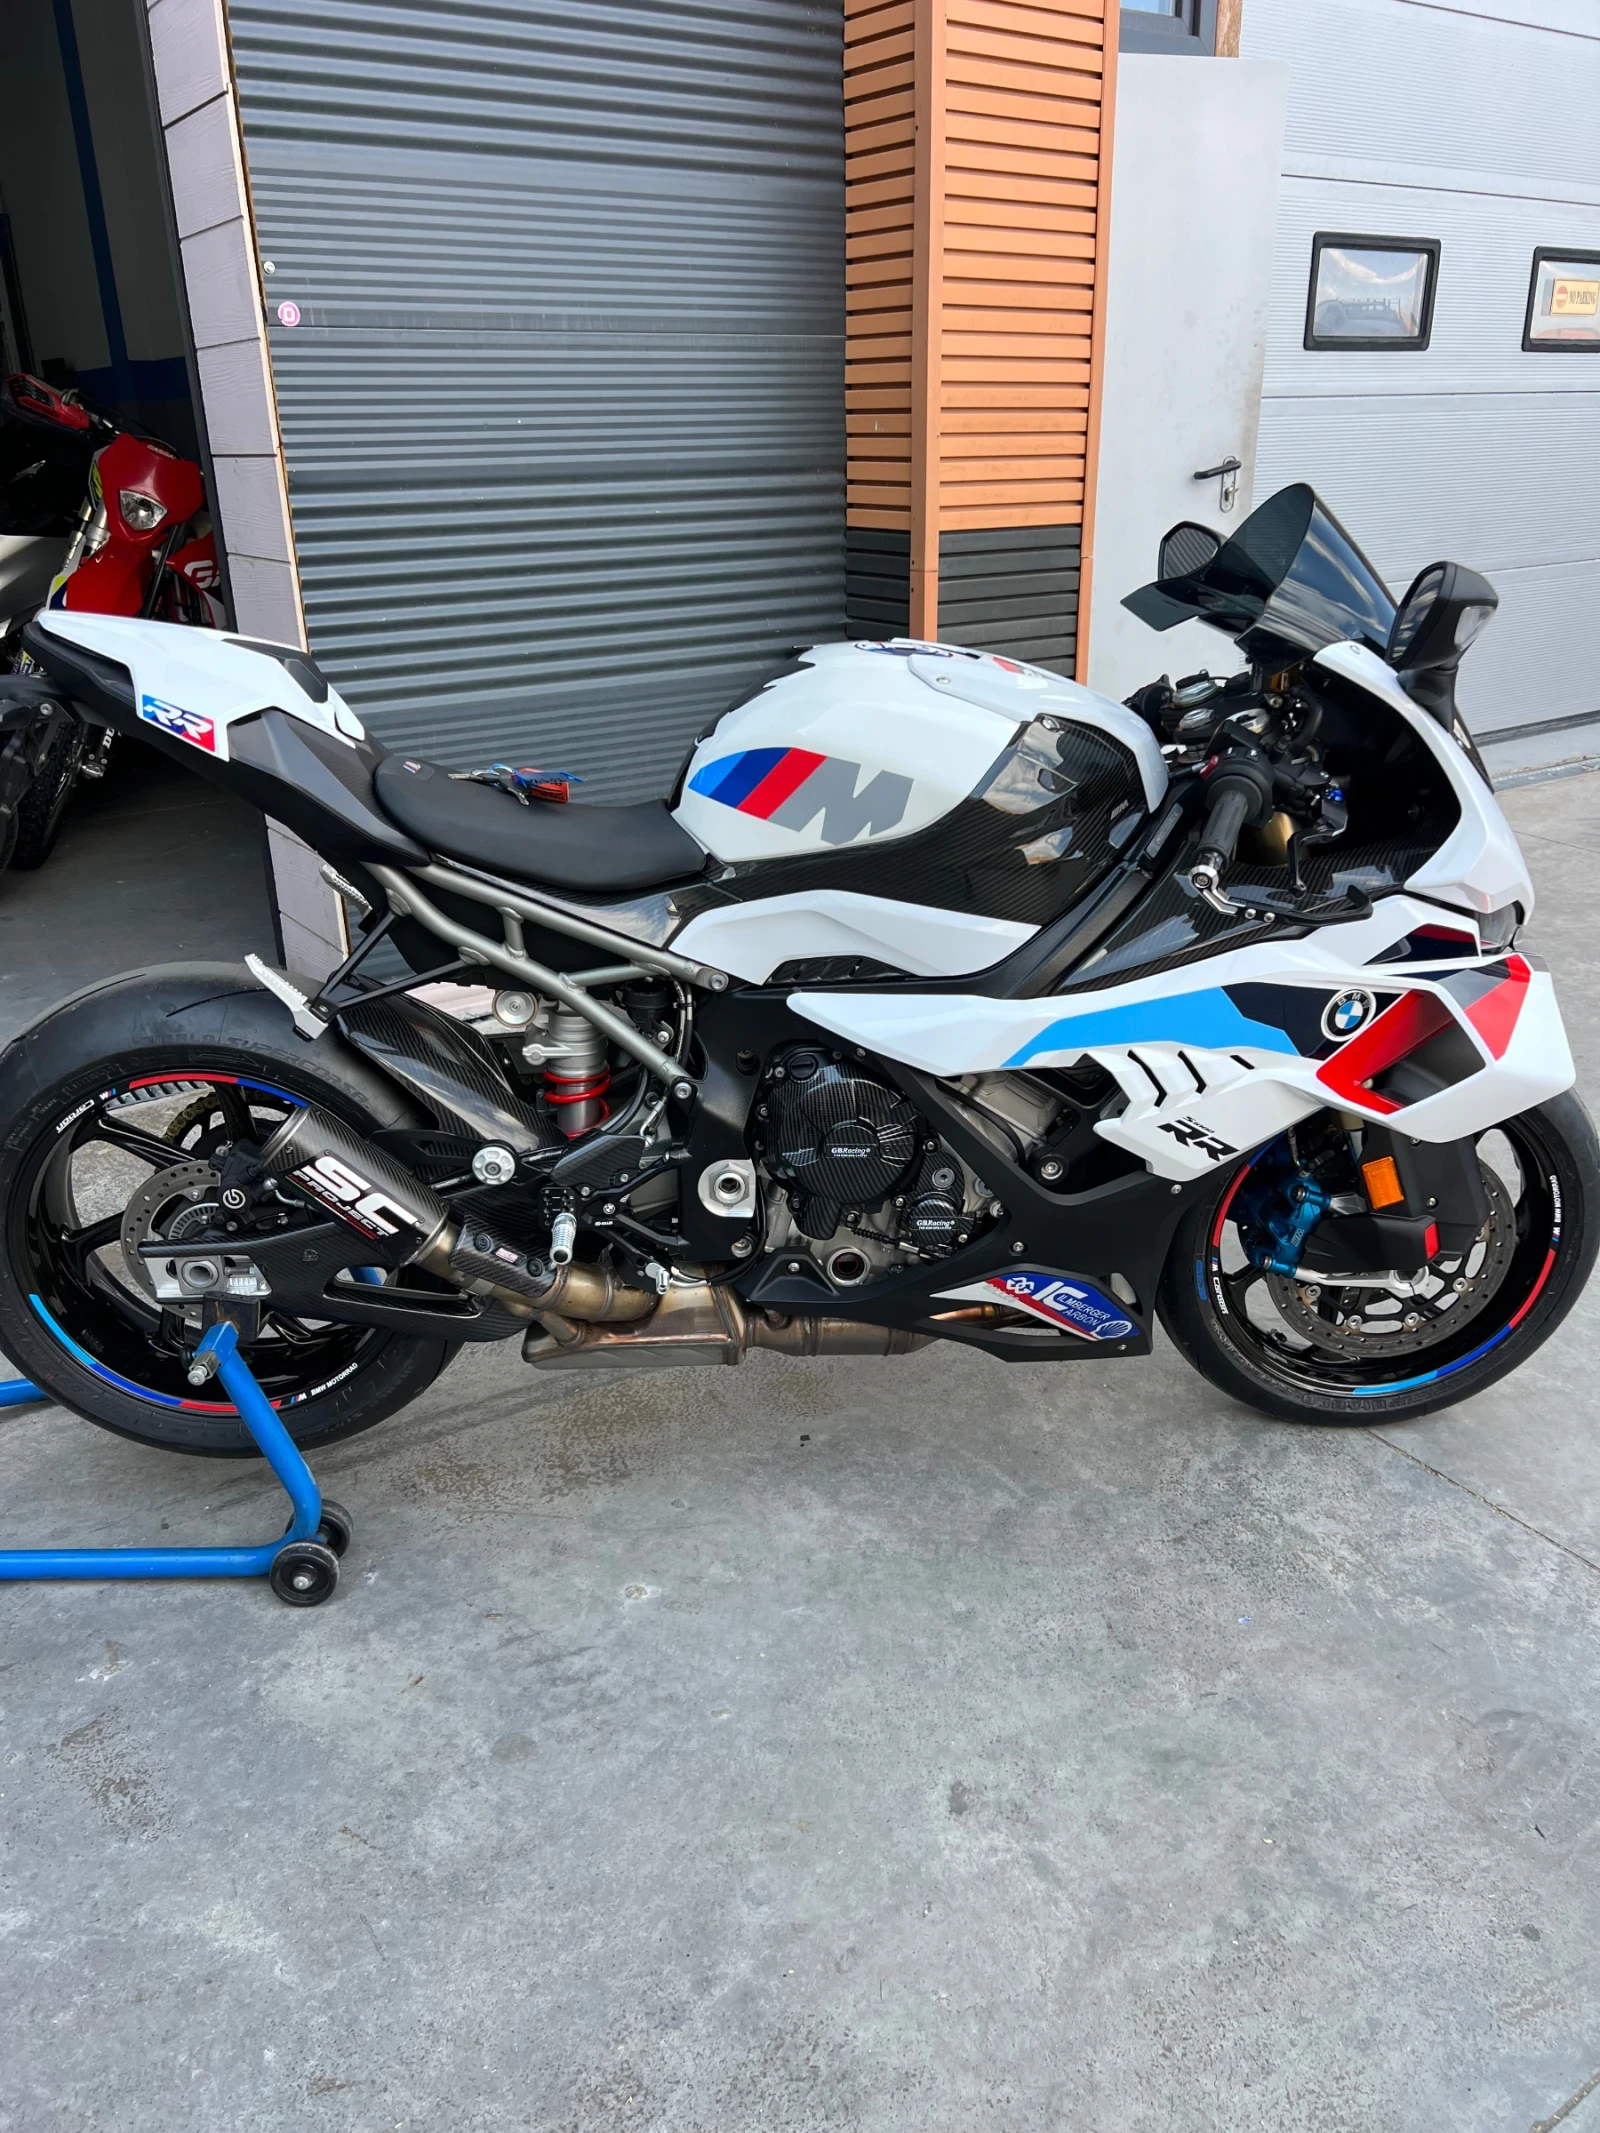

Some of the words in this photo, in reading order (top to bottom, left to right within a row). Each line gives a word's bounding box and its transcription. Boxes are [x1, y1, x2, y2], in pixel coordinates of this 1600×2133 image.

[1576, 290, 1596, 305] PARKING
[143, 700, 213, 740] RR
[1337, 992, 1370, 1008] BMW
[1157, 1119, 1240, 1161] RR
[292, 1170, 390, 1237] PROJECT
[1056, 1294, 1111, 1320] ILMBERGER
[326, 1362, 358, 1388] MOTORRAD
